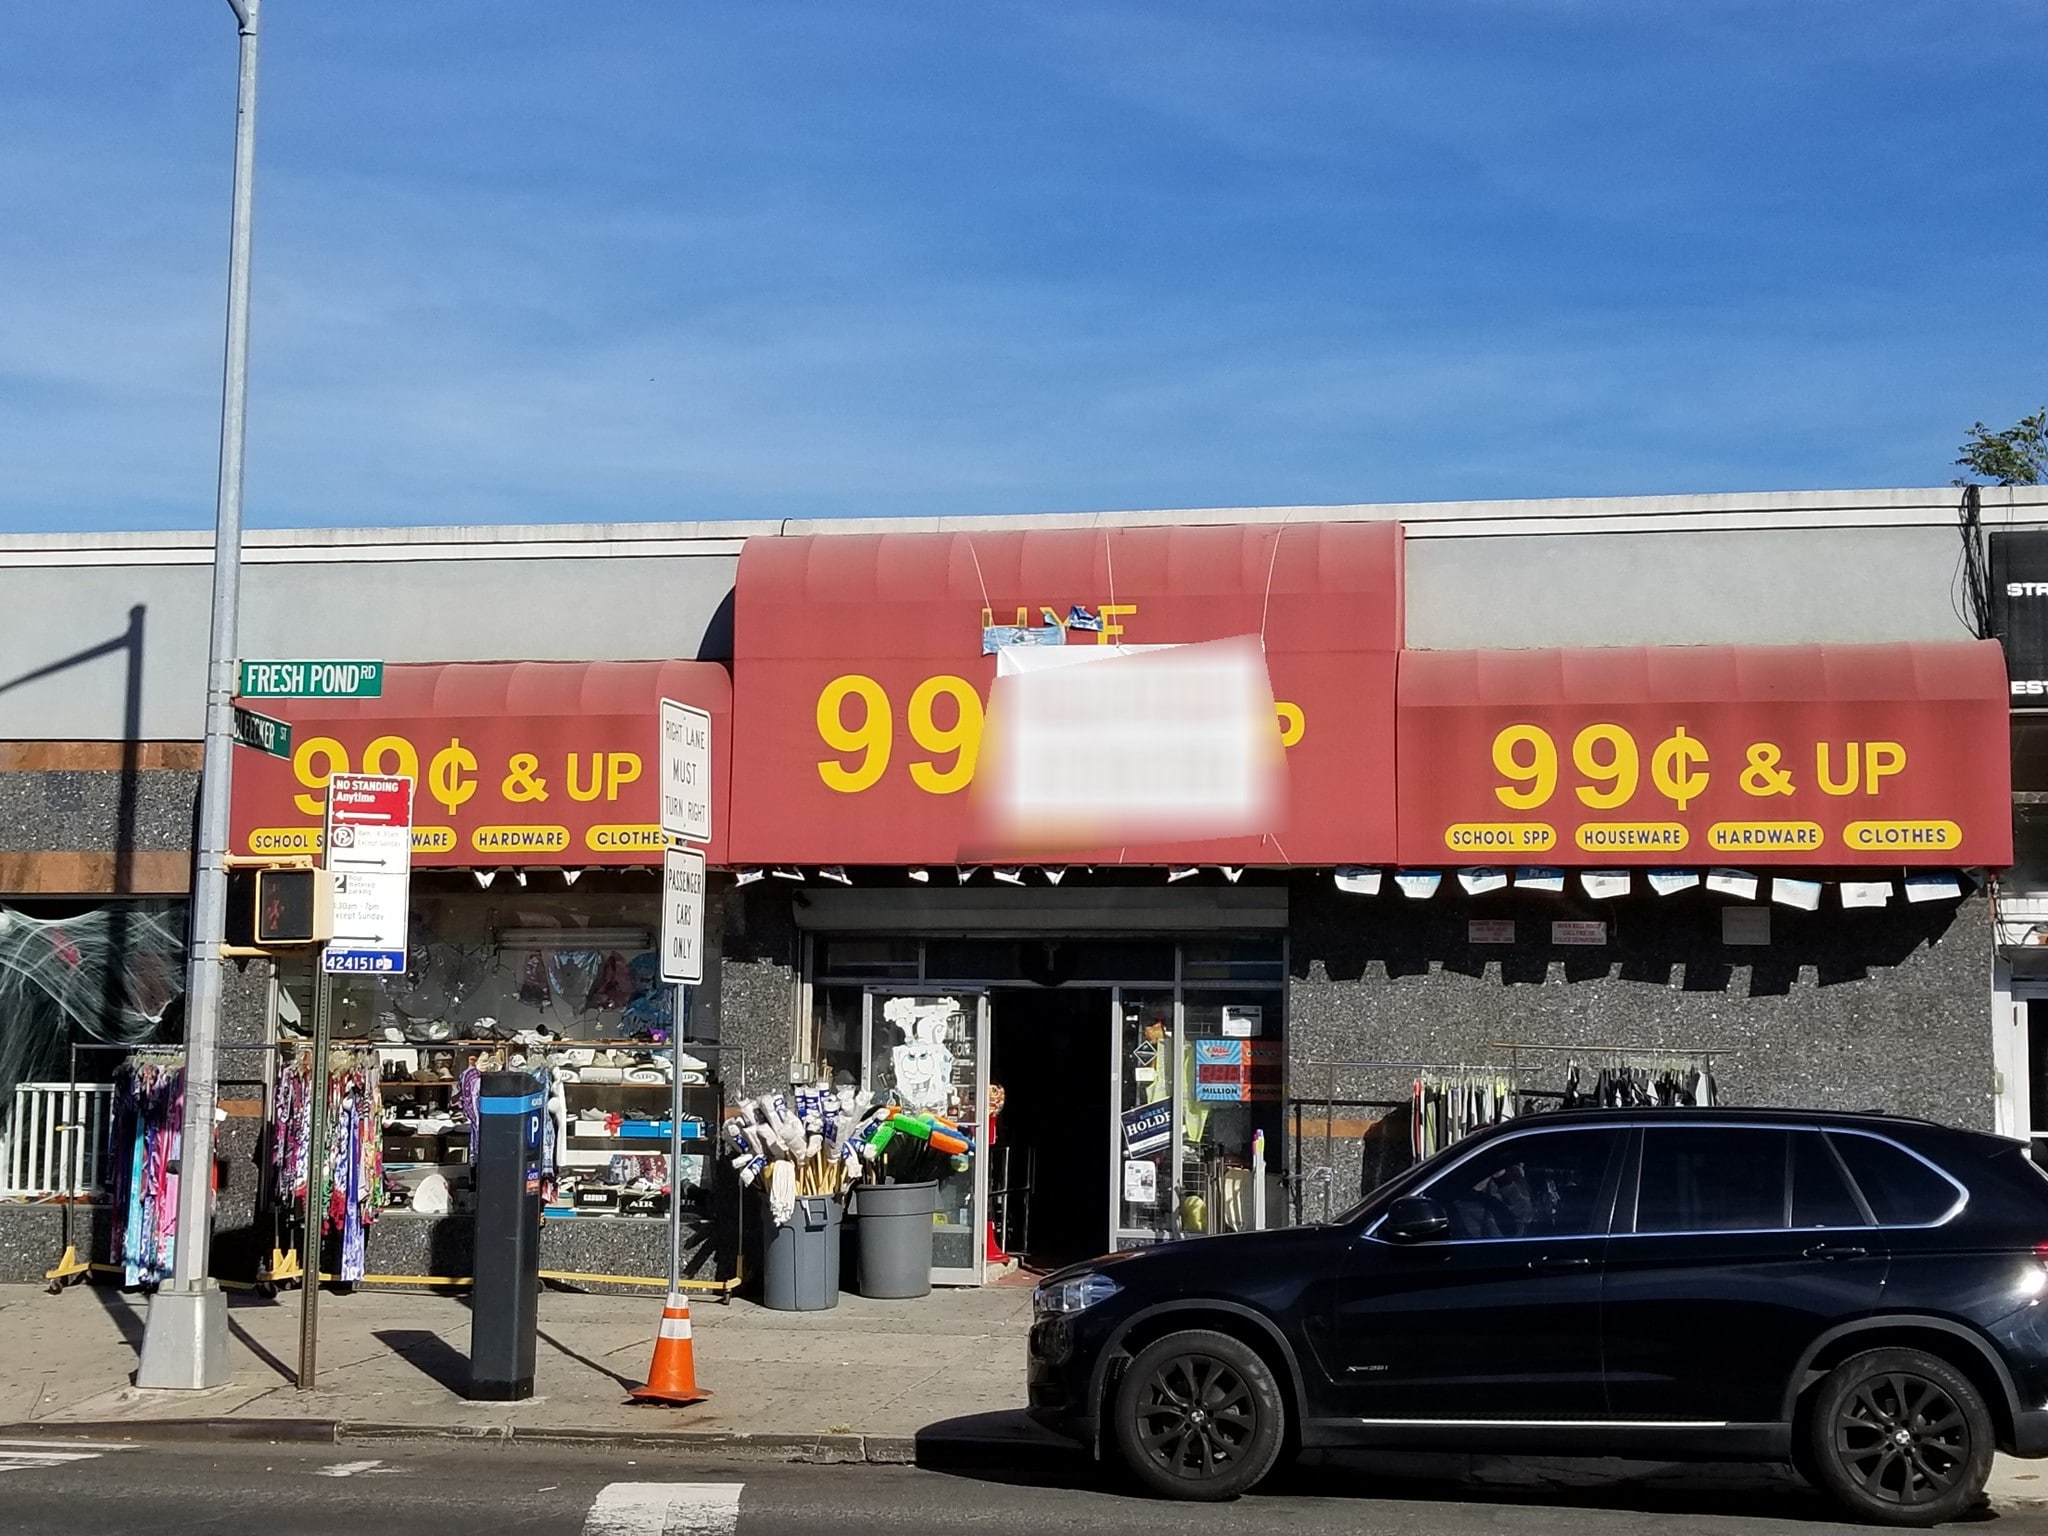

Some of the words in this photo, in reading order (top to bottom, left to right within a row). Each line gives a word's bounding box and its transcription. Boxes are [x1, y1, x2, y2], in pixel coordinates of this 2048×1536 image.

[247, 664, 304, 692] FRESH
[309, 664, 360, 693] POND
[360, 666, 376, 680] RD
[233, 711, 275, 750] BLEECKER
[279, 726, 288, 741] ST
[665, 720, 683, 743] RIGHT
[686, 727, 705, 750] LANE
[673, 758, 697, 786] MUST
[1492, 724, 1710, 811] 99¢
[1740, 743, 1795, 797] &
[1816, 742, 1906, 796] UP
[336, 780, 351, 790] NO
[352, 780, 399, 792] STANDING
[502, 753, 547, 803] &
[567, 753, 642, 802] UP
[336, 792, 376, 804] Anytime
[665, 795, 683, 817] TURN
[688, 802, 705, 822] RIGHT
[255, 834, 308, 848] SCHOOL
[479, 831, 563, 846] HARDWARE
[597, 832, 669, 846] CLOTHES
[1453, 830, 1515, 846] SCHOOL
[1523, 830, 1550, 845] SPP
[1584, 829, 1681, 845] HOUSEWARE
[1716, 828, 1818, 845] HARDWARE
[1859, 828, 1947, 844] CLOTHES
[668, 869, 701, 894] PASSENGER
[336, 912, 355, 920] xcept
[676, 903, 691, 926] CARS
[673, 937, 692, 959] ONLY
[326, 956, 374, 970] 424151
[1202, 1086, 1237, 1095] MILLION
[532, 1116, 539, 1143] P
